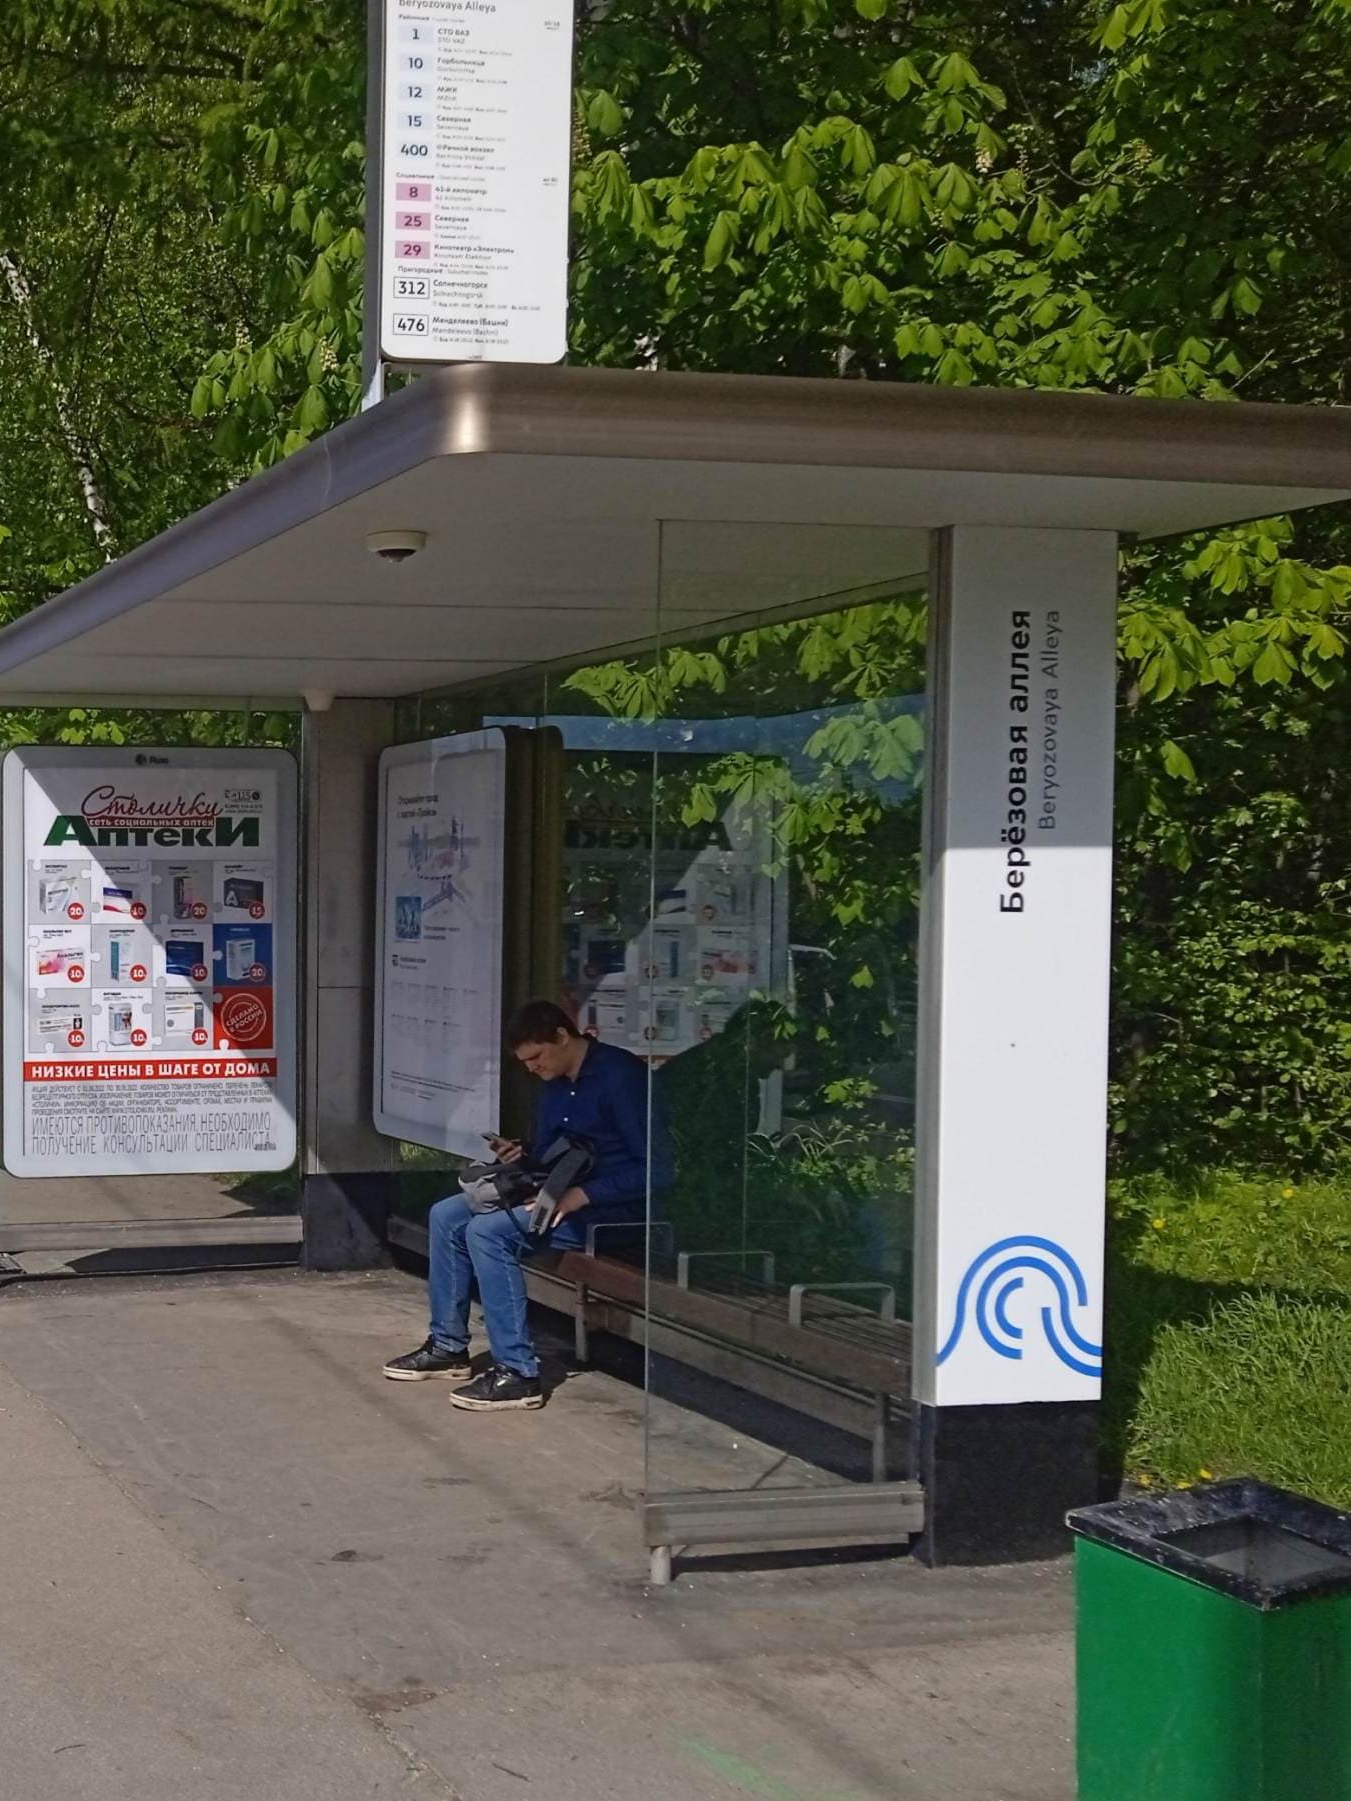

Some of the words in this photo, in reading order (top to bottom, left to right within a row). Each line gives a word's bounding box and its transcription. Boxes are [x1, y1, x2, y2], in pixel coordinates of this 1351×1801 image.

[465, 1, 496, 14] Alleya
[412, 28, 420, 40] 1
[408, 57, 423, 69] 10
[408, 86, 423, 98] 12
[407, 115, 422, 127] 15
[400, 144, 429, 156] 400
[409, 186, 418, 198] 8
[404, 215, 422, 227] 25
[403, 244, 422, 256] 29
[398, 280, 426, 295] 312
[433, 279, 488, 289] Солнечногорск
[397, 317, 426, 332] 476
[1041, 610, 1064, 679] Alleya
[1010, 610, 1031, 713] аллея
[1038, 688, 1062, 830] Beryozovaya
[81, 785, 225, 818] Столички
[89, 818, 112, 828] сеть
[114, 818, 181, 828] социальных
[183, 818, 214, 827] аптек
[1000, 724, 1031, 913] Берёзовая
[32, 1065, 94, 1078] НИЗКИЕ
[98, 1064, 141, 1079] ЦЕНЫ
[145, 1064, 154, 1076] В
[158, 1063, 199, 1076] ШАГЕ
[202, 1063, 222, 1075] ОТ
[224, 1062, 270, 1077] ДОМА
[32, 1115, 84, 1136] ИМЕЮТСЯ
[200, 1112, 271, 1133] НЕОБХОДИМО
[32, 1135, 97, 1156] ПОЛУЧЕНИЕ
[103, 1133, 188, 1154] КОНСУЛЬТАЦИИ
